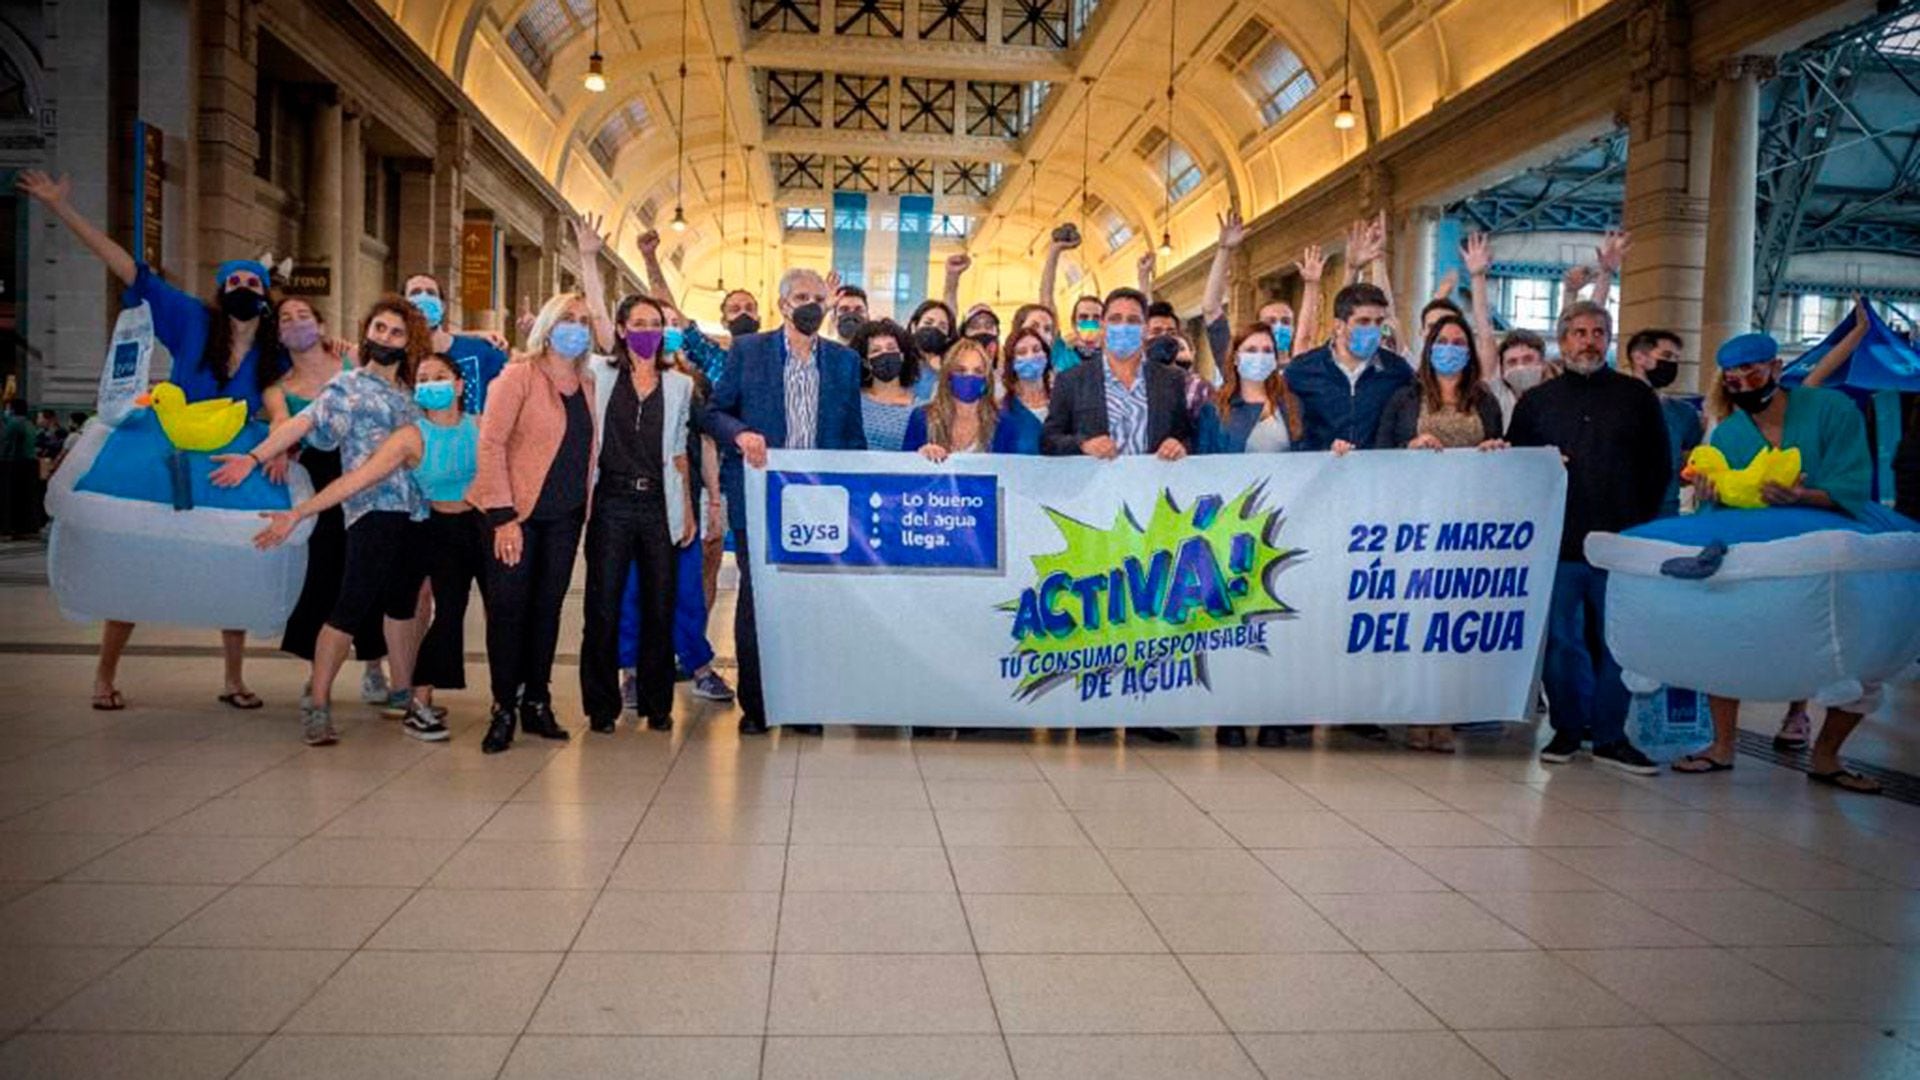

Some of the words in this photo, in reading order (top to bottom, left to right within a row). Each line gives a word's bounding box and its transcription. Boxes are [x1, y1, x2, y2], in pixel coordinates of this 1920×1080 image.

[902, 492, 923, 508] Lo
[928, 492, 984, 508] bueno
[789, 523, 840, 546] aysa
[902, 512, 928, 527] del
[934, 514, 976, 531] agua
[1348, 524, 1389, 553] 22
[1395, 523, 1430, 552] DE
[1435, 520, 1535, 552] MARZO
[902, 530, 950, 549] llega.
[1348, 557, 1397, 601] DÍA
[1404, 566, 1530, 601] MUNDIAL
[1346, 611, 1410, 653] DEL
[1422, 610, 1526, 653] AGUA
[1000, 656, 1022, 679] TU
[1028, 642, 1127, 675] CONSUMO
[1133, 621, 1267, 662] RESPONSABLE
[1080, 672, 1112, 701] DE
[1121, 657, 1194, 696] AGUA
